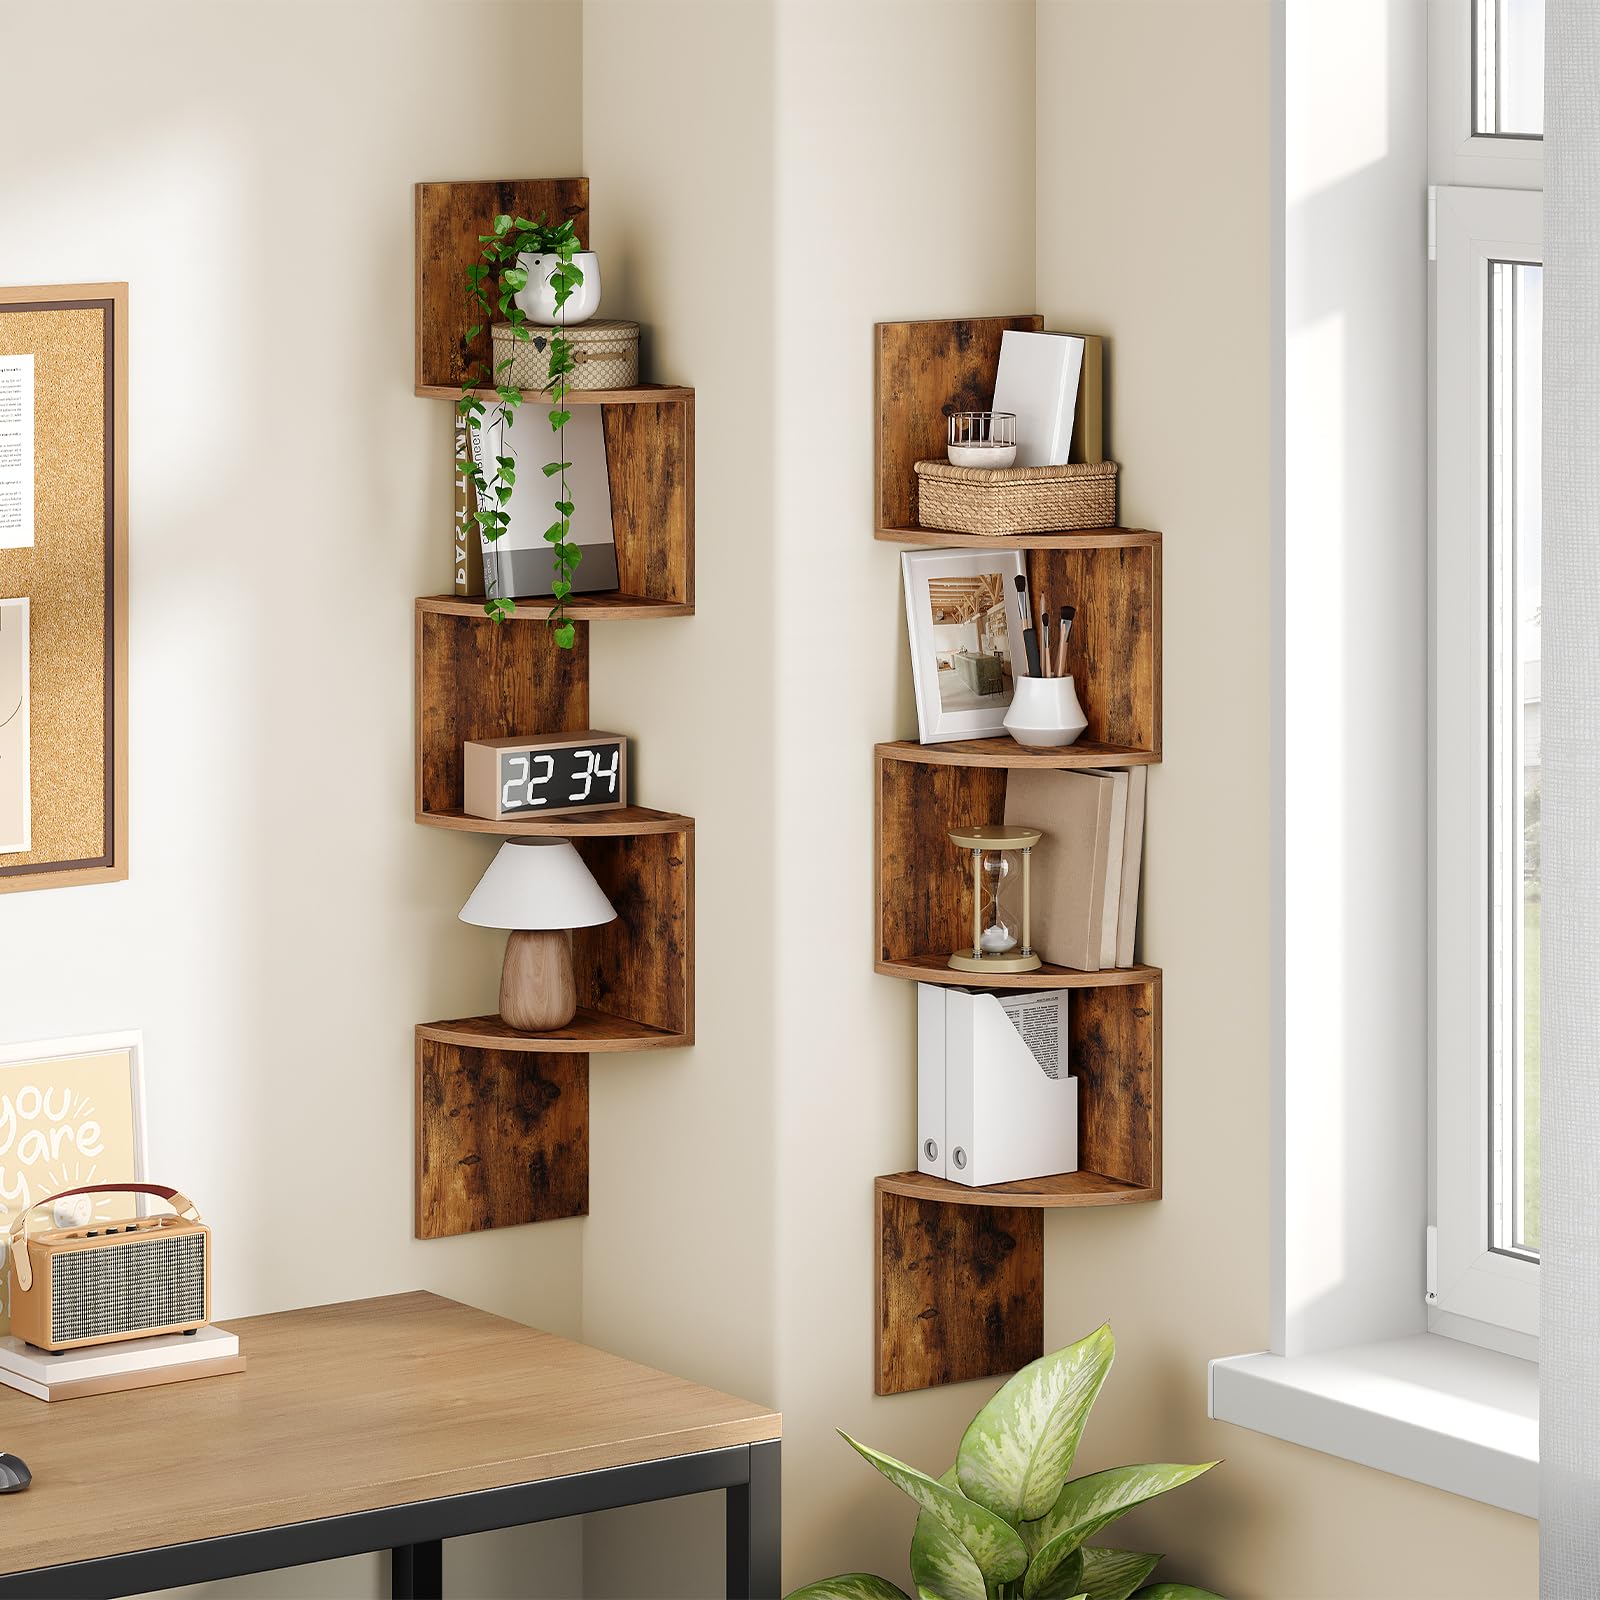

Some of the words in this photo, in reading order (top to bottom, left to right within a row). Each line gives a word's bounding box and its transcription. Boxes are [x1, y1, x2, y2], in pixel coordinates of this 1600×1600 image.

[502, 755, 554, 808] 22
[568, 750, 619, 801] 34
[0, 1085, 71, 1156] you
[17, 1121, 104, 1165] are
